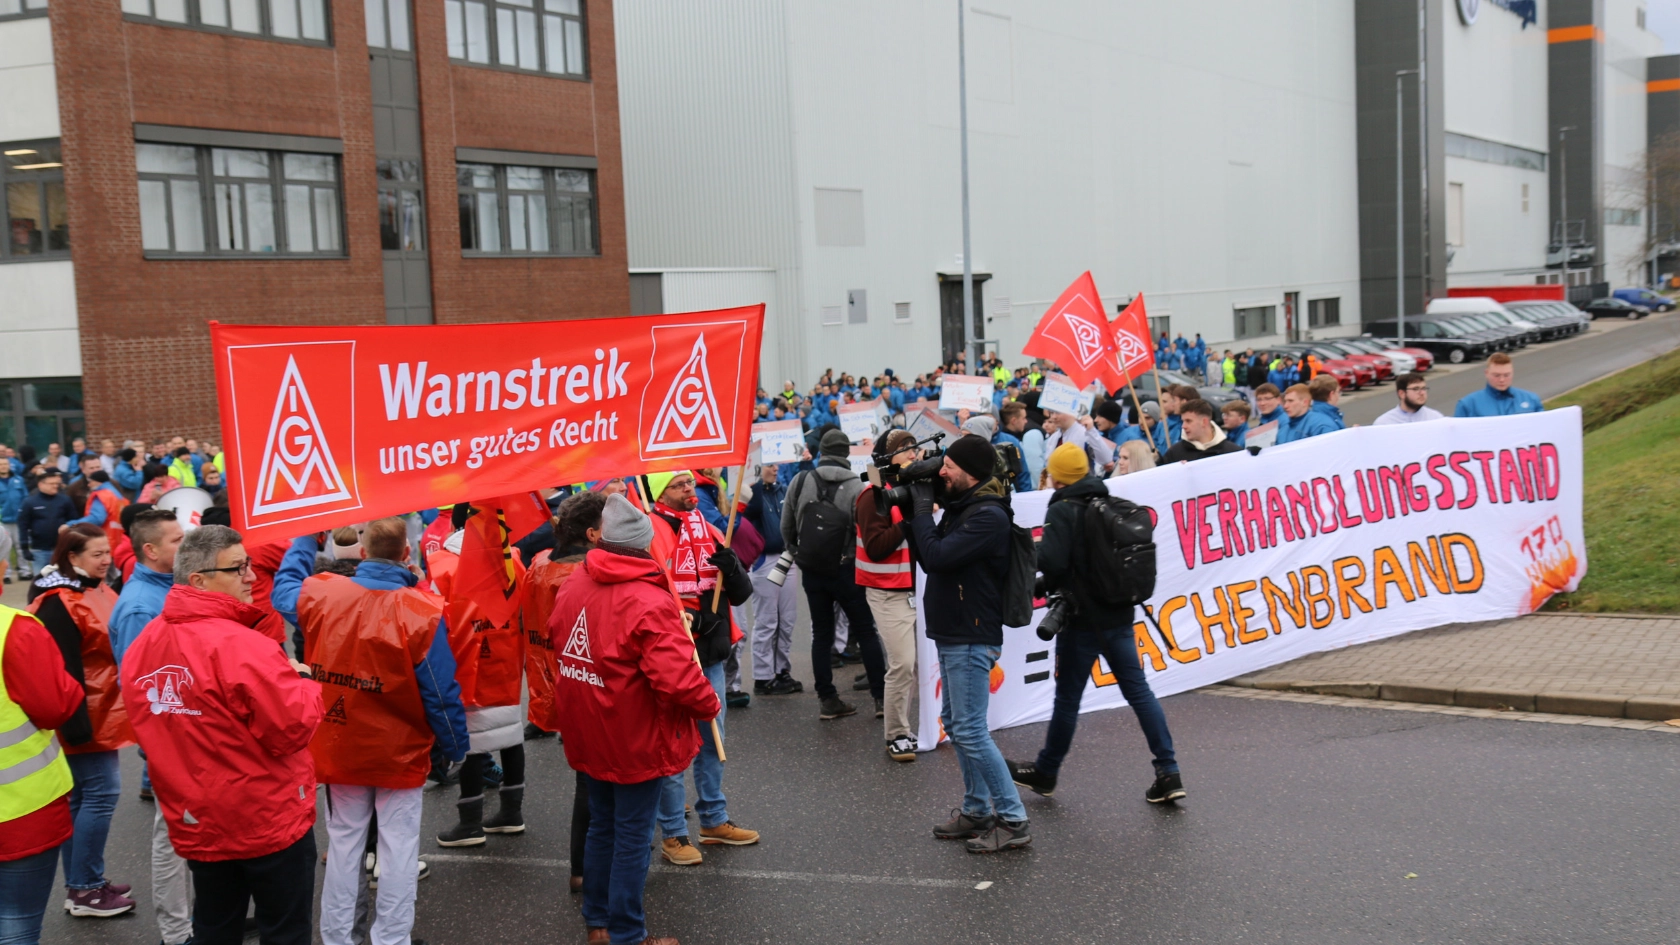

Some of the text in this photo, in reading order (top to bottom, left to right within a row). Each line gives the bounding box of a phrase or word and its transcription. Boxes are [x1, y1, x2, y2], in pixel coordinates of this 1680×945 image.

[379, 346, 631, 421] Warnstreik
[379, 409, 619, 475] unser gutes Recht
[1172, 442, 1561, 570] VERHANDLUNGSSTAND
[1056, 531, 1486, 688] LÄCHENBRAND
[311, 662, 385, 694] Warnstreik
[557, 658, 605, 688] Zwickau
